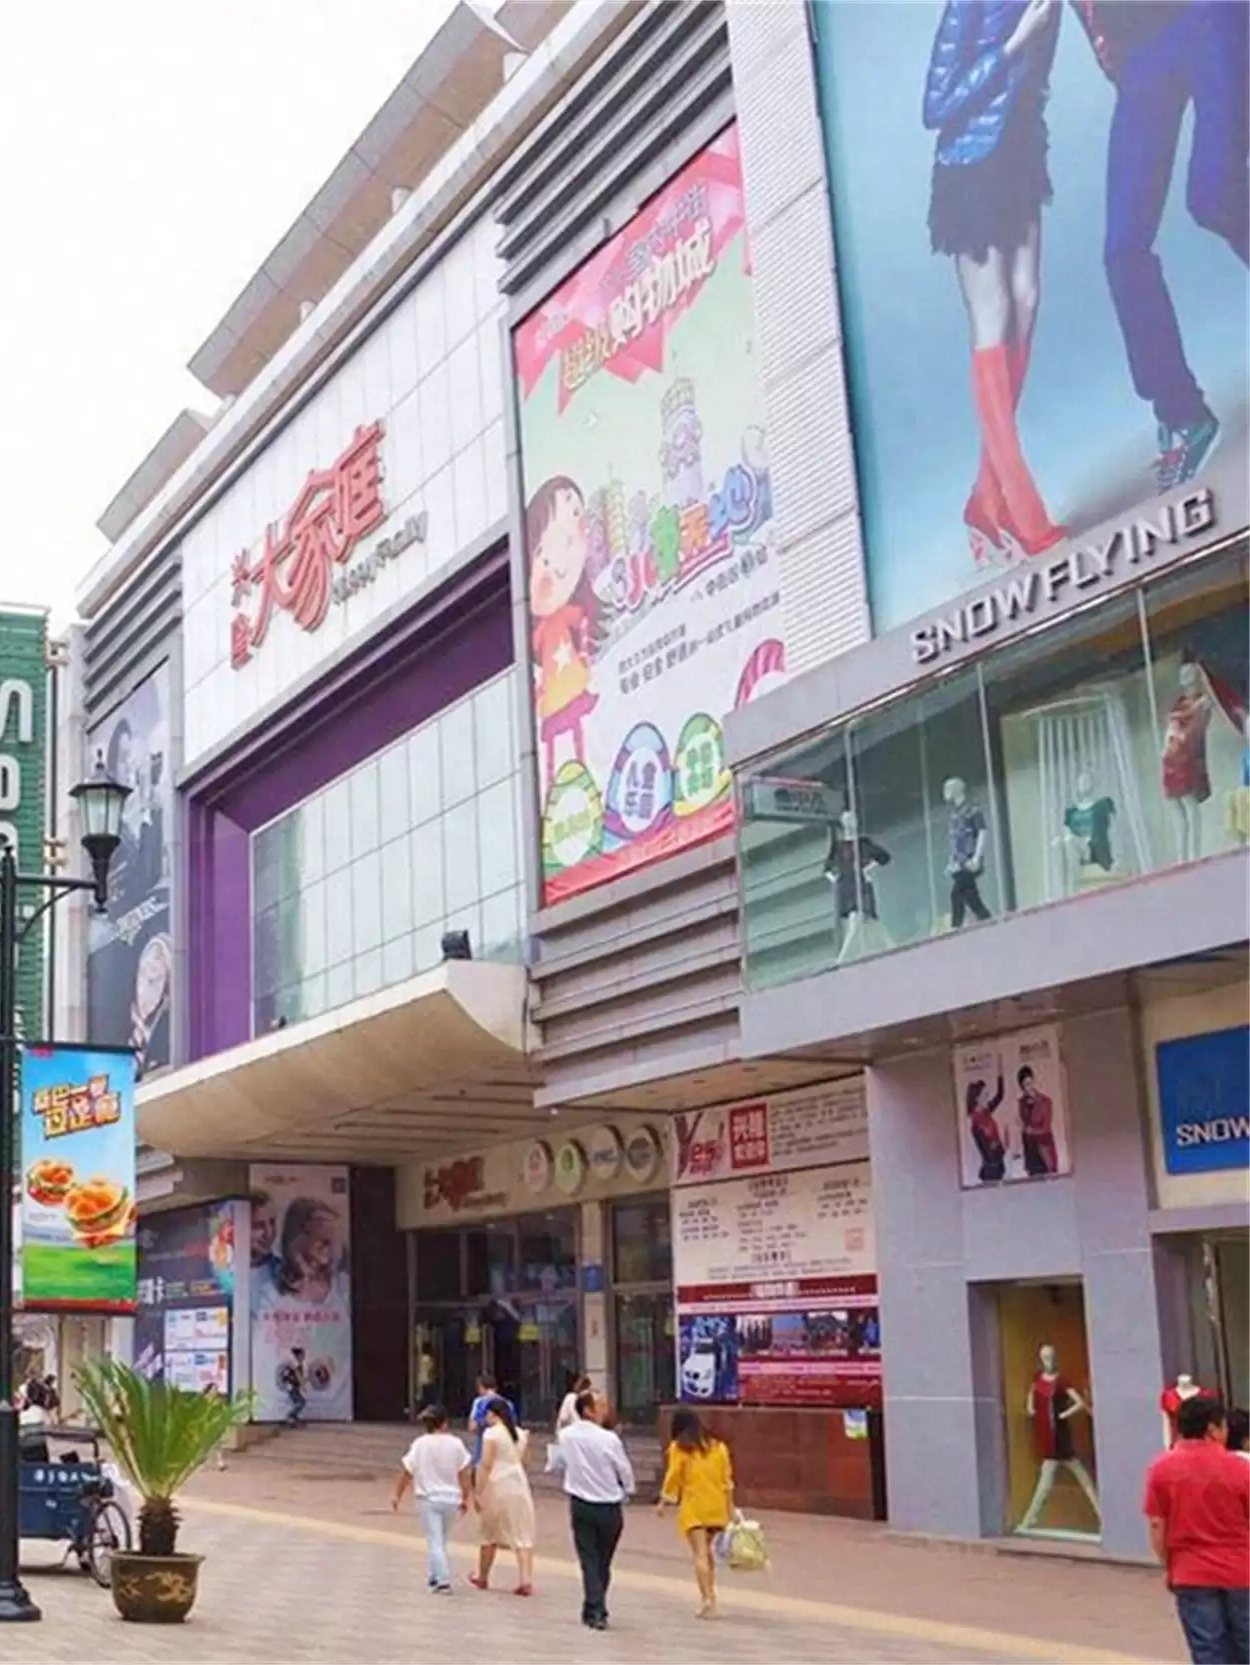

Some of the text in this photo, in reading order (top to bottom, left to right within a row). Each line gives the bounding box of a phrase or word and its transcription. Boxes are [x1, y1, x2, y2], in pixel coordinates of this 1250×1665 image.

[249, 417, 388, 650] 大家庭
[1176, 1116, 1250, 1146] SNOW
